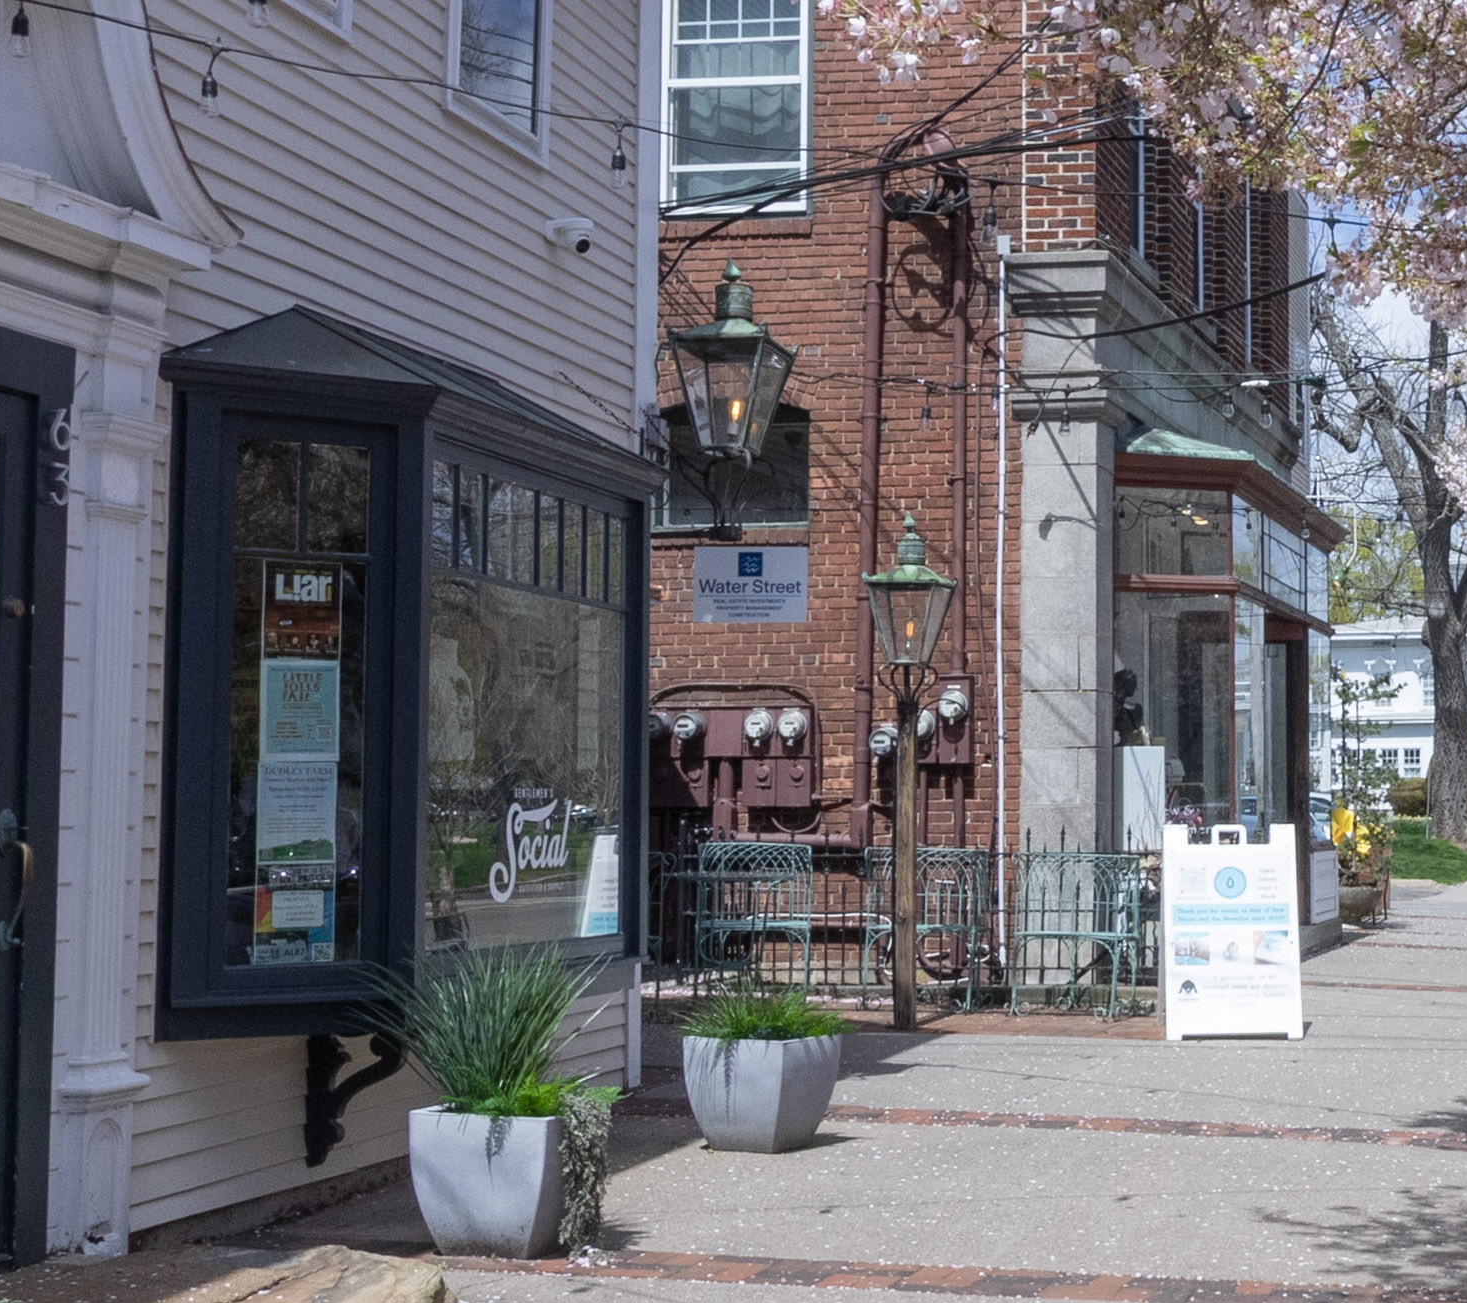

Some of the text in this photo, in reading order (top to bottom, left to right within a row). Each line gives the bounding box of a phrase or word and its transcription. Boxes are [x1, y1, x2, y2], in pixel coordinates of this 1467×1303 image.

[698, 578, 802, 594] Water Street
[283, 672, 323, 681] LITTLE
[306, 767, 333, 775] FARM
[514, 787, 554, 799] GENTLEMEN'S
[489, 798, 573, 904] Social
